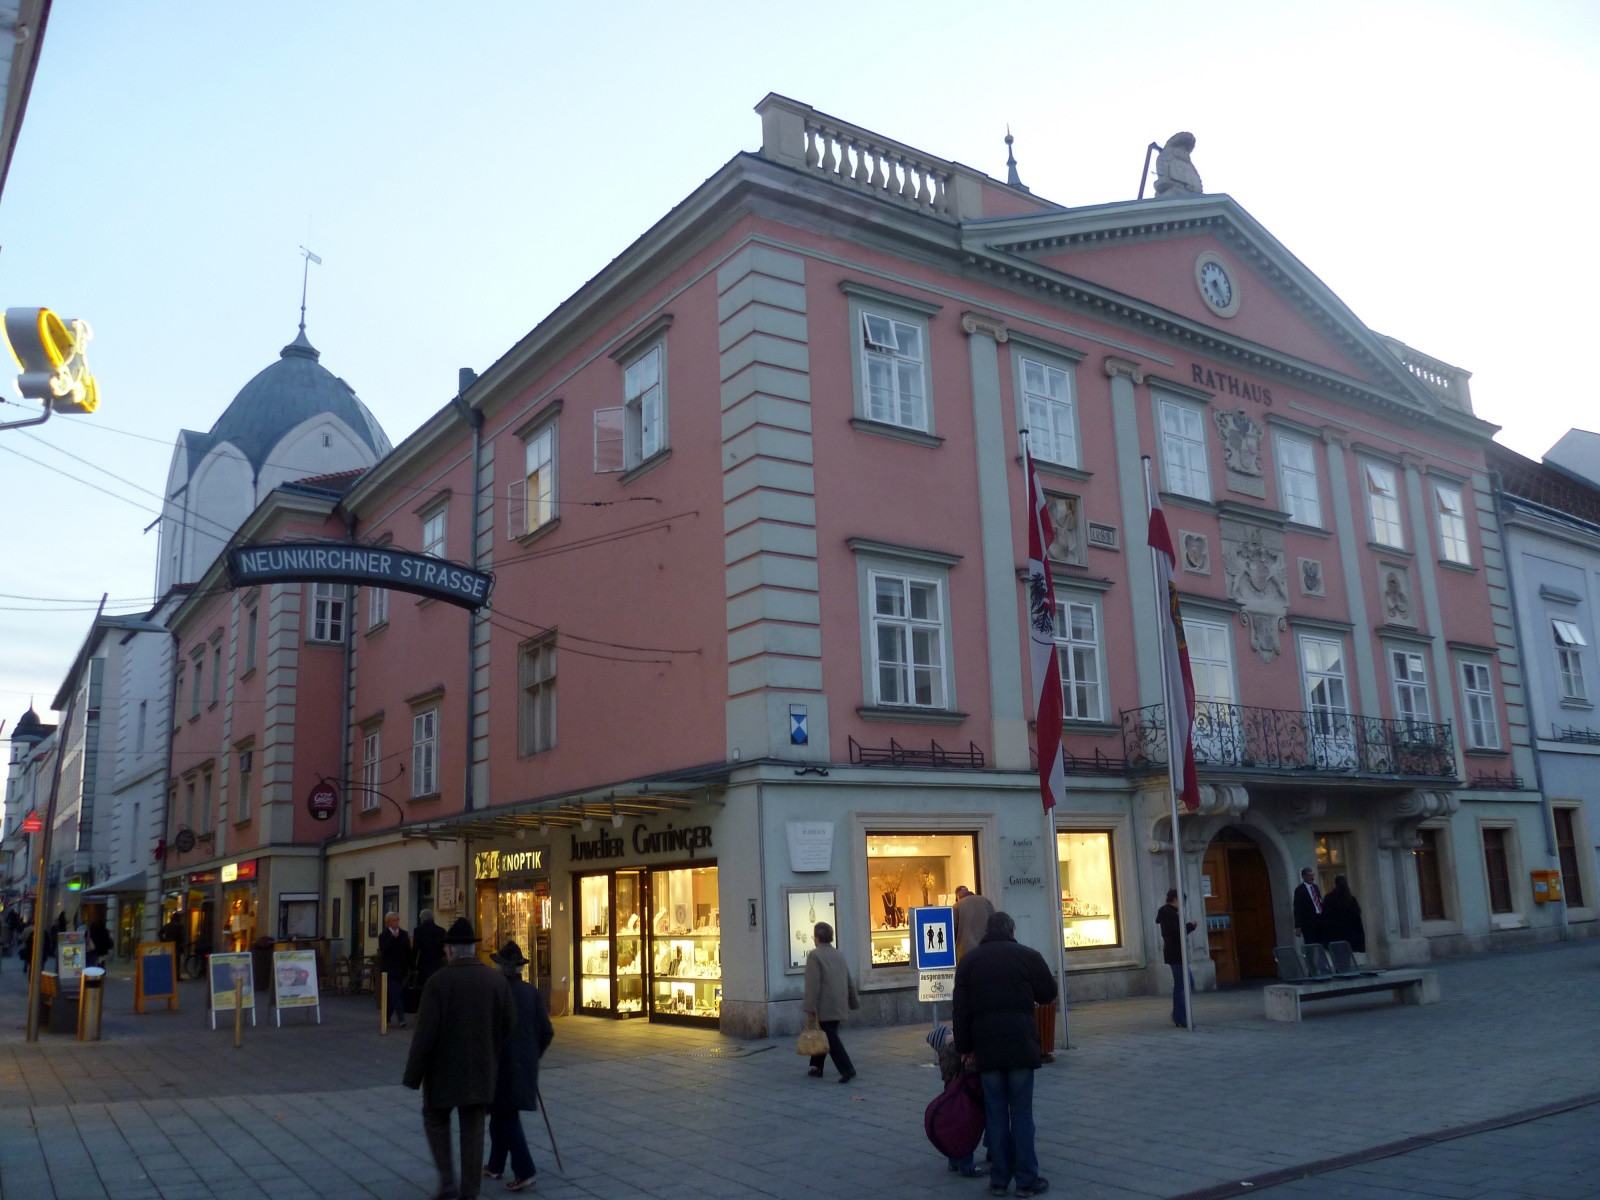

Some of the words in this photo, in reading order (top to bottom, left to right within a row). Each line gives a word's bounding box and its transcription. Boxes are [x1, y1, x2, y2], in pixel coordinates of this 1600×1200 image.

[1191, 362, 1273, 407] RATHAUS
[241, 550, 391, 574] NEUNKIRCHNER
[400, 559, 486, 598] STRASSE
